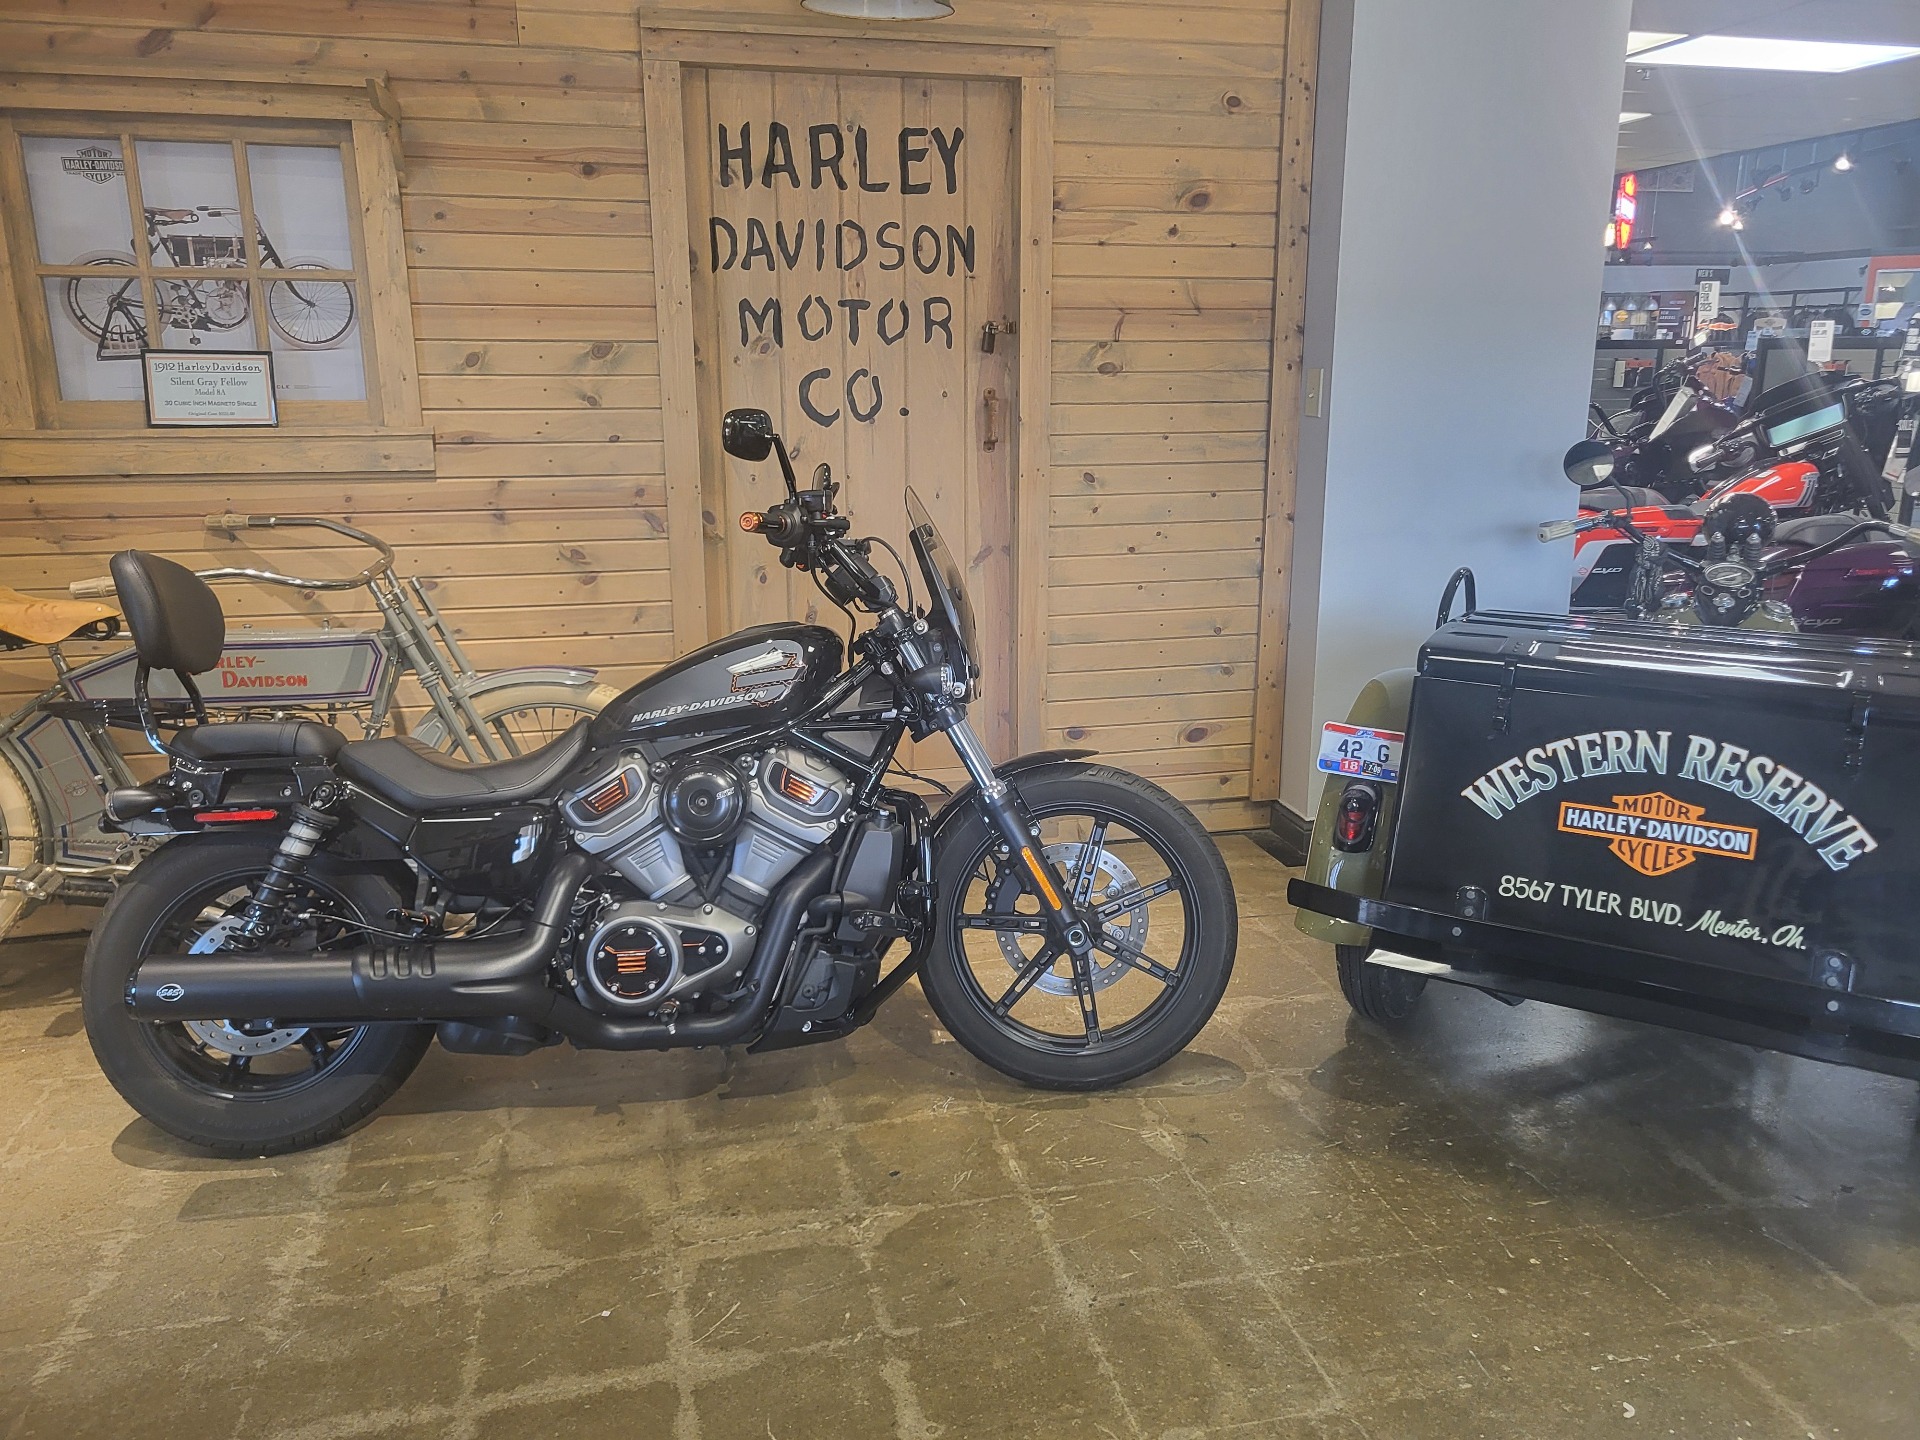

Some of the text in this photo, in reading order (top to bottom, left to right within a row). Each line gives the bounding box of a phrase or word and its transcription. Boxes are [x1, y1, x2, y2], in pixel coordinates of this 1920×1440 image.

[64, 159, 124, 170] HARLEY-DAVIDSO
[80, 149, 109, 158] MOTOR
[718, 121, 965, 194] HARLEY
[85, 172, 112, 182] CYCLES
[709, 216, 976, 277] DAVIDSON
[739, 294, 953, 350] MOTOR
[154, 362, 176, 373] 1912
[170, 377, 249, 388] Silent Gray Fellow
[194, 388, 226, 396] Model 8A
[798, 367, 909, 427] CO.
[1803, 618, 1842, 626] CVO
[215, 656, 265, 669] RLEY-
[221, 670, 308, 689] DAVIDSON
[631, 689, 769, 723] HARLEY-DAVIDSON
[1338, 739, 1390, 763] 42 G
[1342, 760, 1359, 771] 18
[1460, 729, 1879, 872] WESTERN RESERVE
[1622, 794, 1691, 821] MOTOR
[1565, 808, 1750, 852] HARLEY-DAVIDSON
[1617, 838, 1687, 873] CYCLES
[1498, 875, 1807, 950] 8567 TYLER BLVD. Mentor, Oh.
